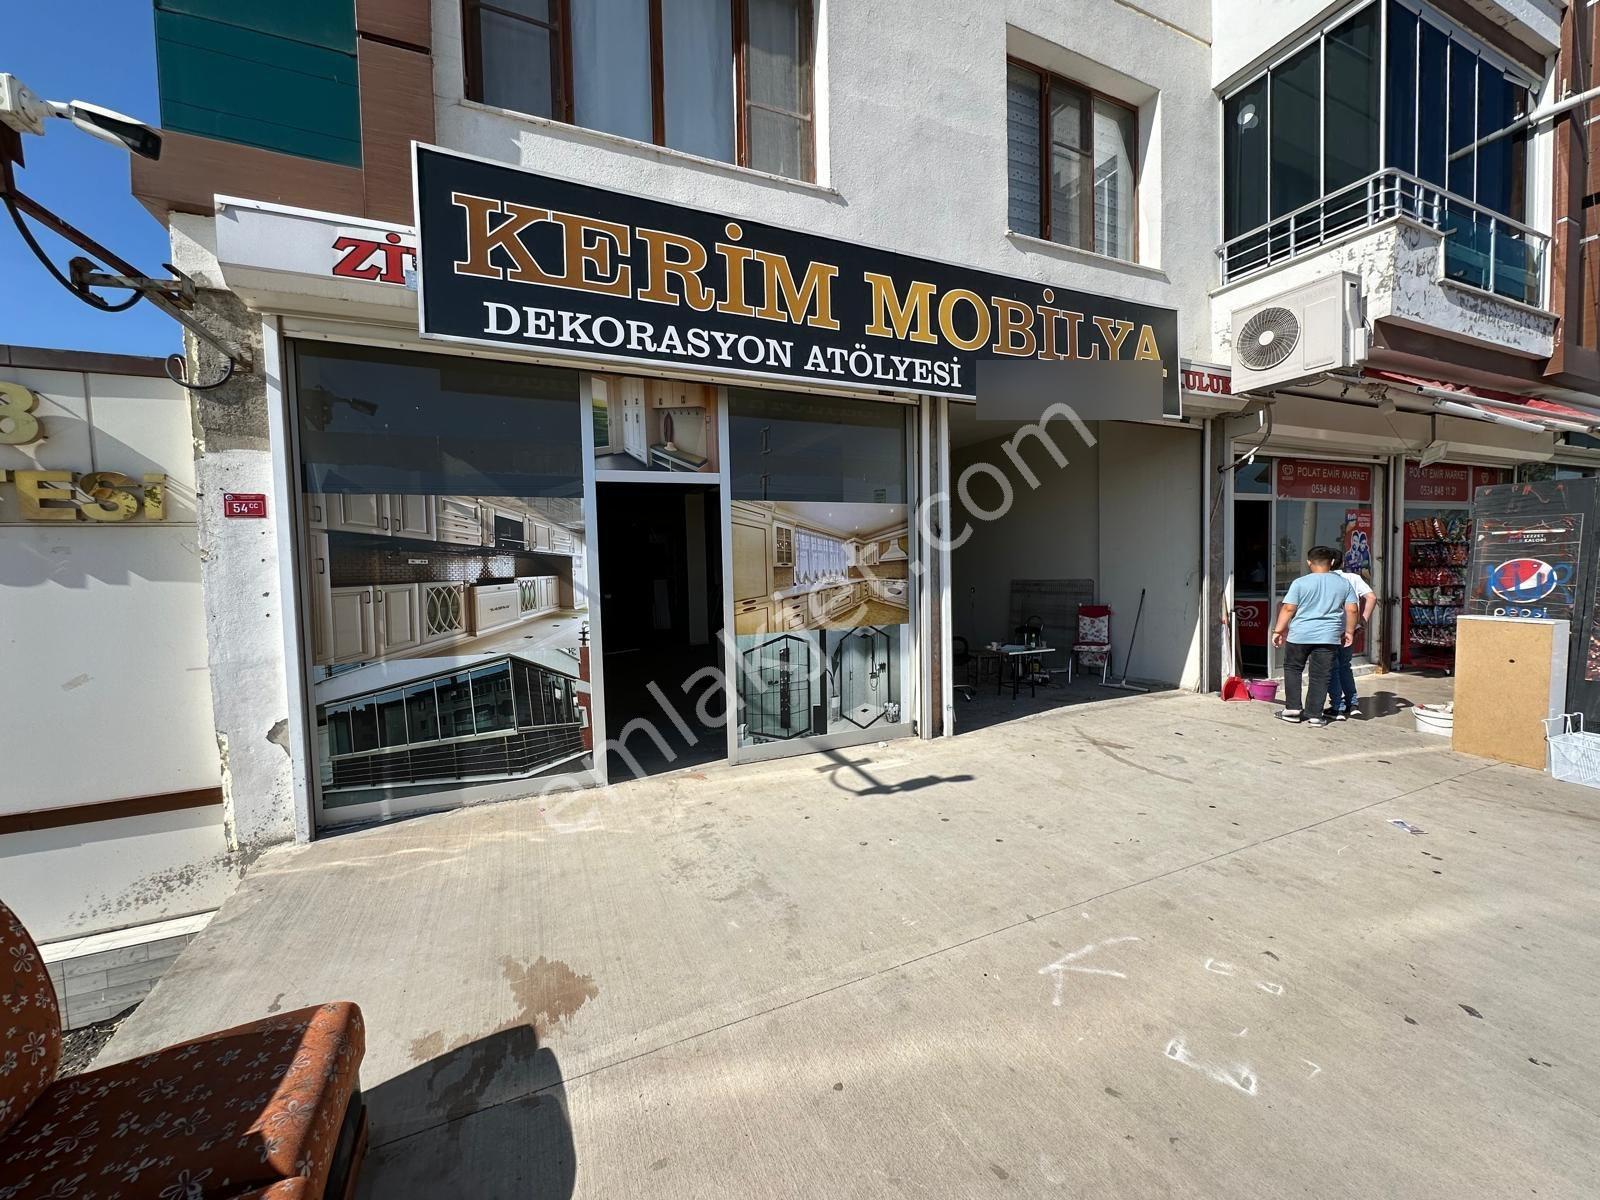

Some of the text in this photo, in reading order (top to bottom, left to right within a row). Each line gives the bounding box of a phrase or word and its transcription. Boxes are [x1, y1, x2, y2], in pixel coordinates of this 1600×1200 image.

[332, 233, 416, 284] Zİ
[452, 192, 1168, 378] KERİM MOBİLYA
[483, 301, 962, 389] DEKORASYON ATÖLYESİ
[1181, 369, 1232, 396] ULUK
[0, 469, 165, 521] ESİ
[1297, 466, 1321, 477] POLAT
[1341, 470, 1369, 480] MARKET
